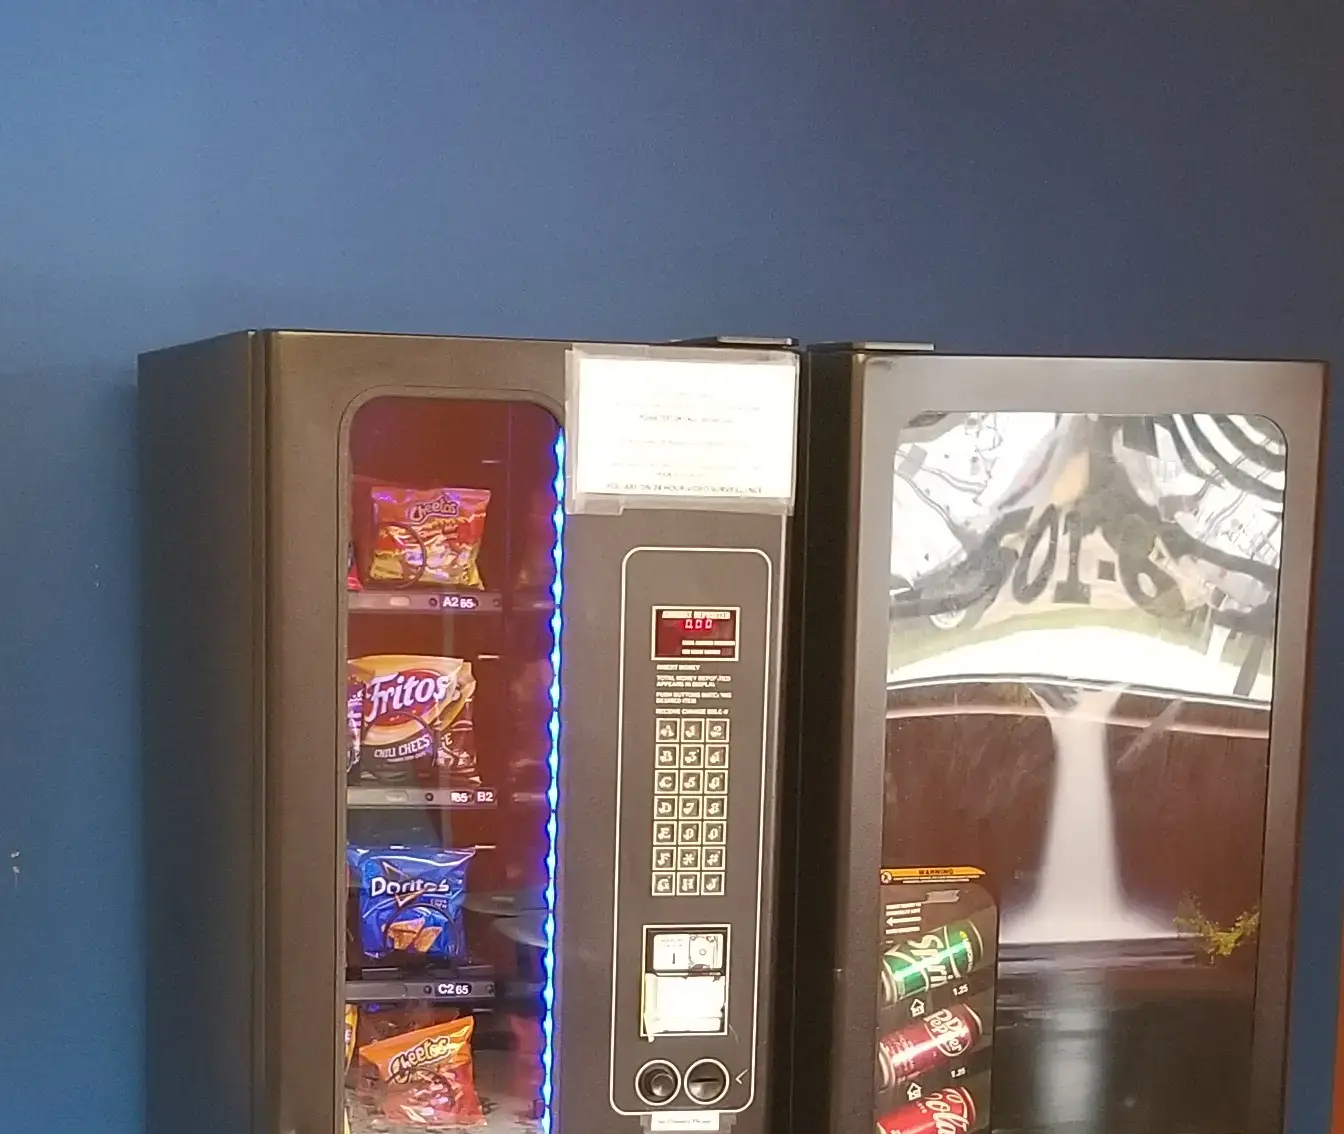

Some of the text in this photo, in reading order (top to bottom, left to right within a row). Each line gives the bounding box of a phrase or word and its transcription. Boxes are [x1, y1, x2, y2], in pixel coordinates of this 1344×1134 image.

[409, 496, 458, 521] Cheetos
[442, 597, 459, 608] A2
[363, 672, 452, 723] Fritos
[398, 734, 431, 755] CHEES
[477, 791, 494, 802] B2
[371, 876, 450, 897] Doritos
[438, 984, 469, 995] C2 65
[952, 983, 969, 996] 1.25
[923, 1008, 963, 1053] Peper
[390, 1035, 451, 1084] Cheetos
[950, 1066, 966, 1078] 1.25
